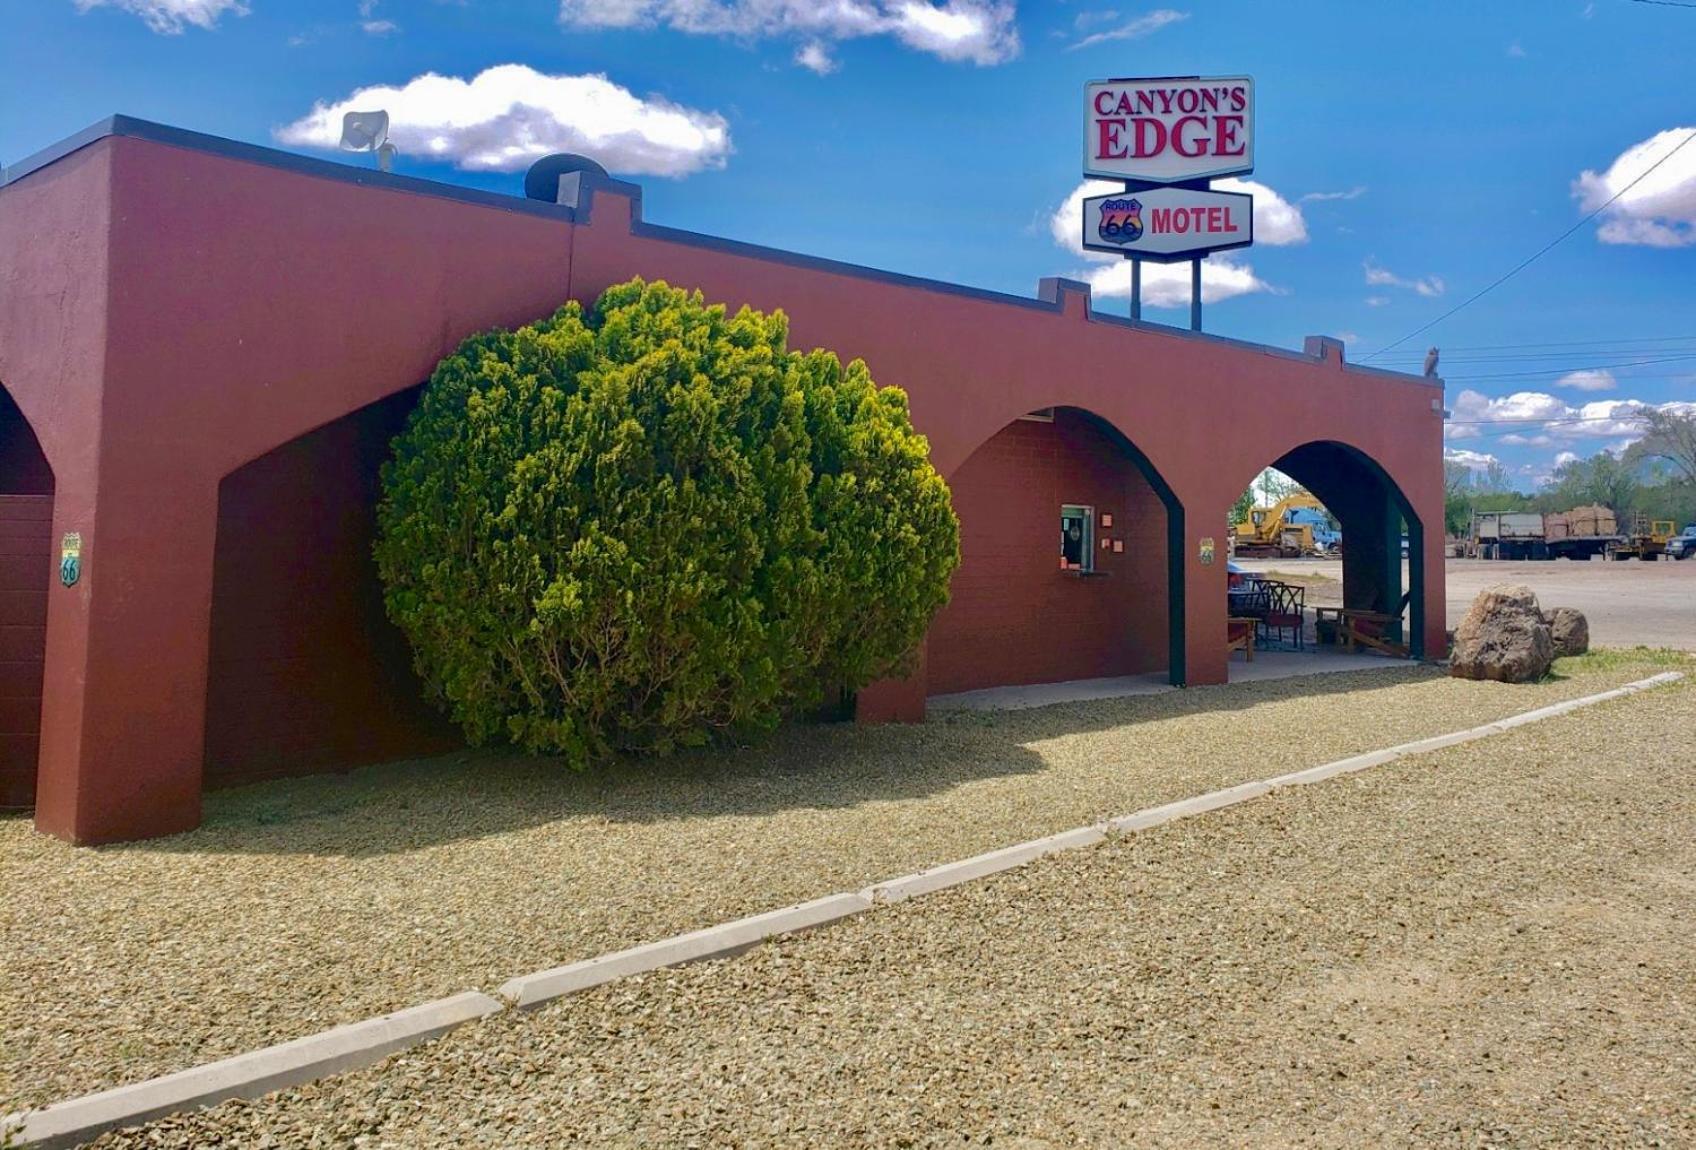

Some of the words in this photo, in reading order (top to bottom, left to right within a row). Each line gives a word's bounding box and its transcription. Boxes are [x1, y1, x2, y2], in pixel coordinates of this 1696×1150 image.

[1094, 87, 1246, 116] CANYON'S
[1095, 115, 1246, 160] EDGE
[1105, 201, 1137, 211] ROUTE
[1105, 214, 1138, 236] 66
[1151, 206, 1238, 234] MOTEL
[63, 559, 76, 581] 66
